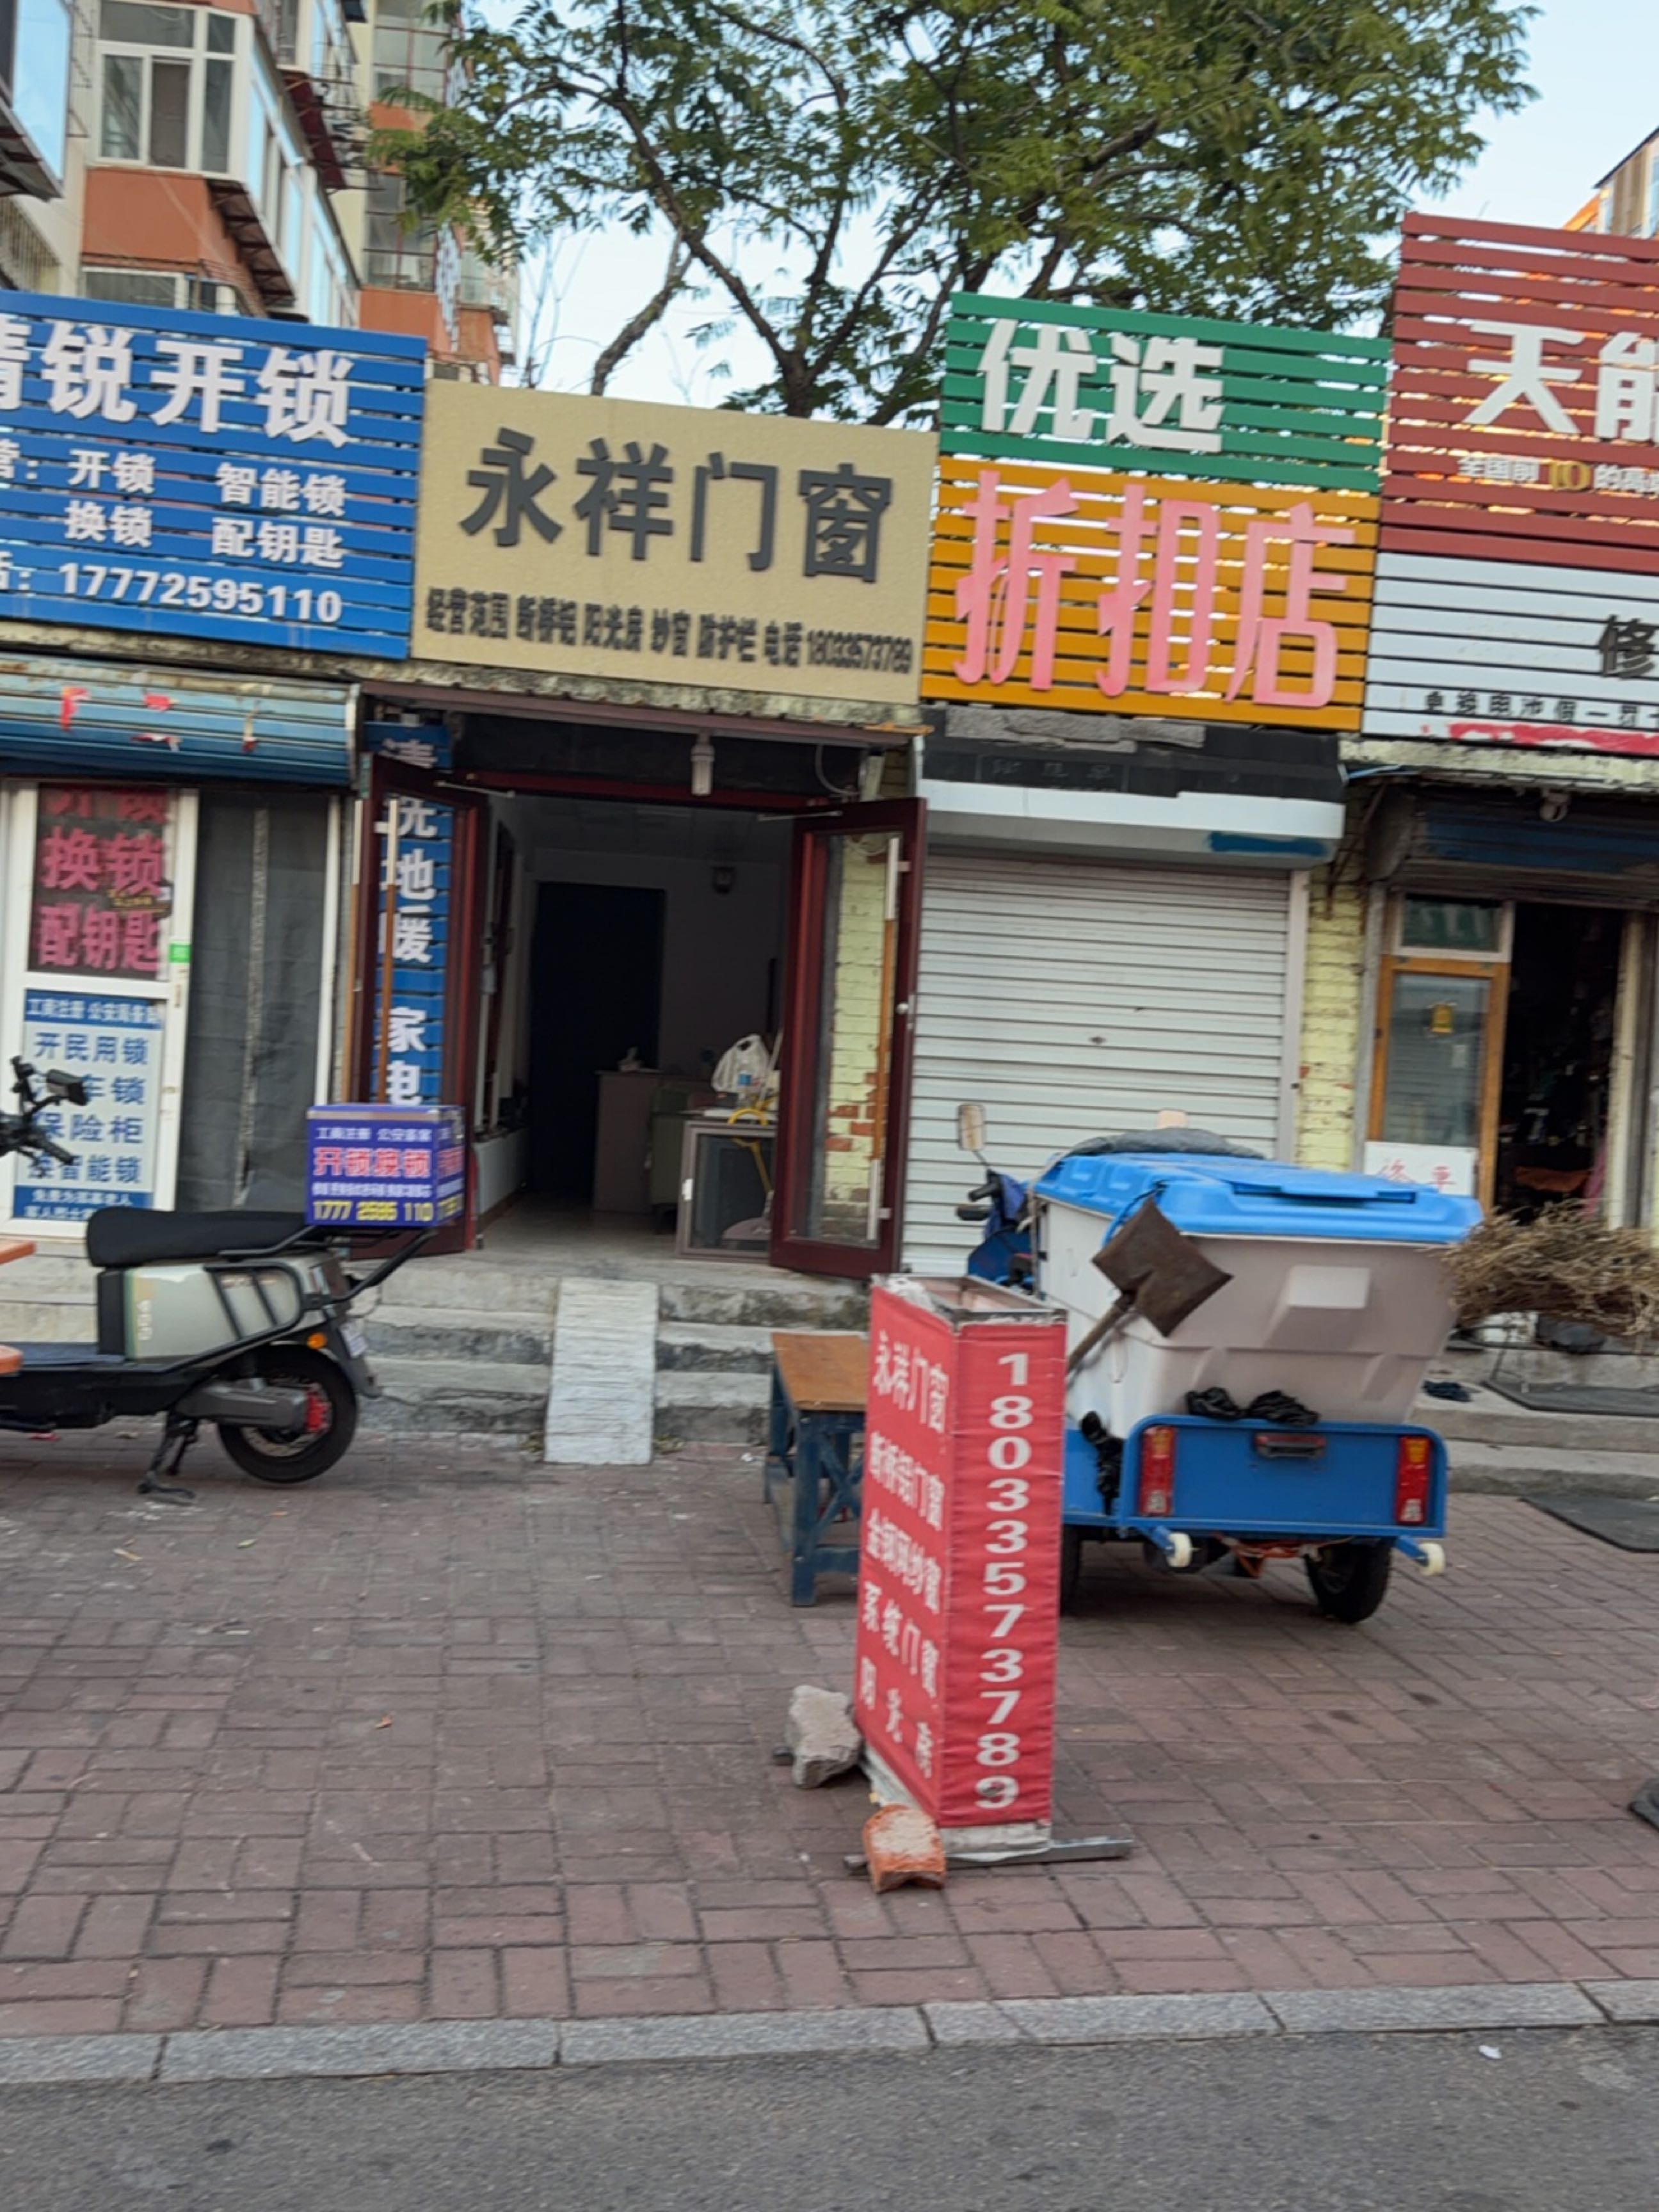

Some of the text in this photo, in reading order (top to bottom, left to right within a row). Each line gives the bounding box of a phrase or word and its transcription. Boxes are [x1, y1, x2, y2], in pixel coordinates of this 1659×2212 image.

[978, 319, 1226, 452] 优选
[217, 463, 346, 517] 智能锁
[460, 427, 892, 582] 永祥门窗
[65, 501, 345, 568] 换锁 配钥匙
[953, 470, 1355, 709] 折扣店
[1598, 615, 1658, 680] 修
[42, 826, 163, 897] 换锁
[40, 903, 159, 972] 配钥匙
[34, 1032, 148, 1065] 开民用锁
[974, 1352, 1034, 1810] 18033573789
